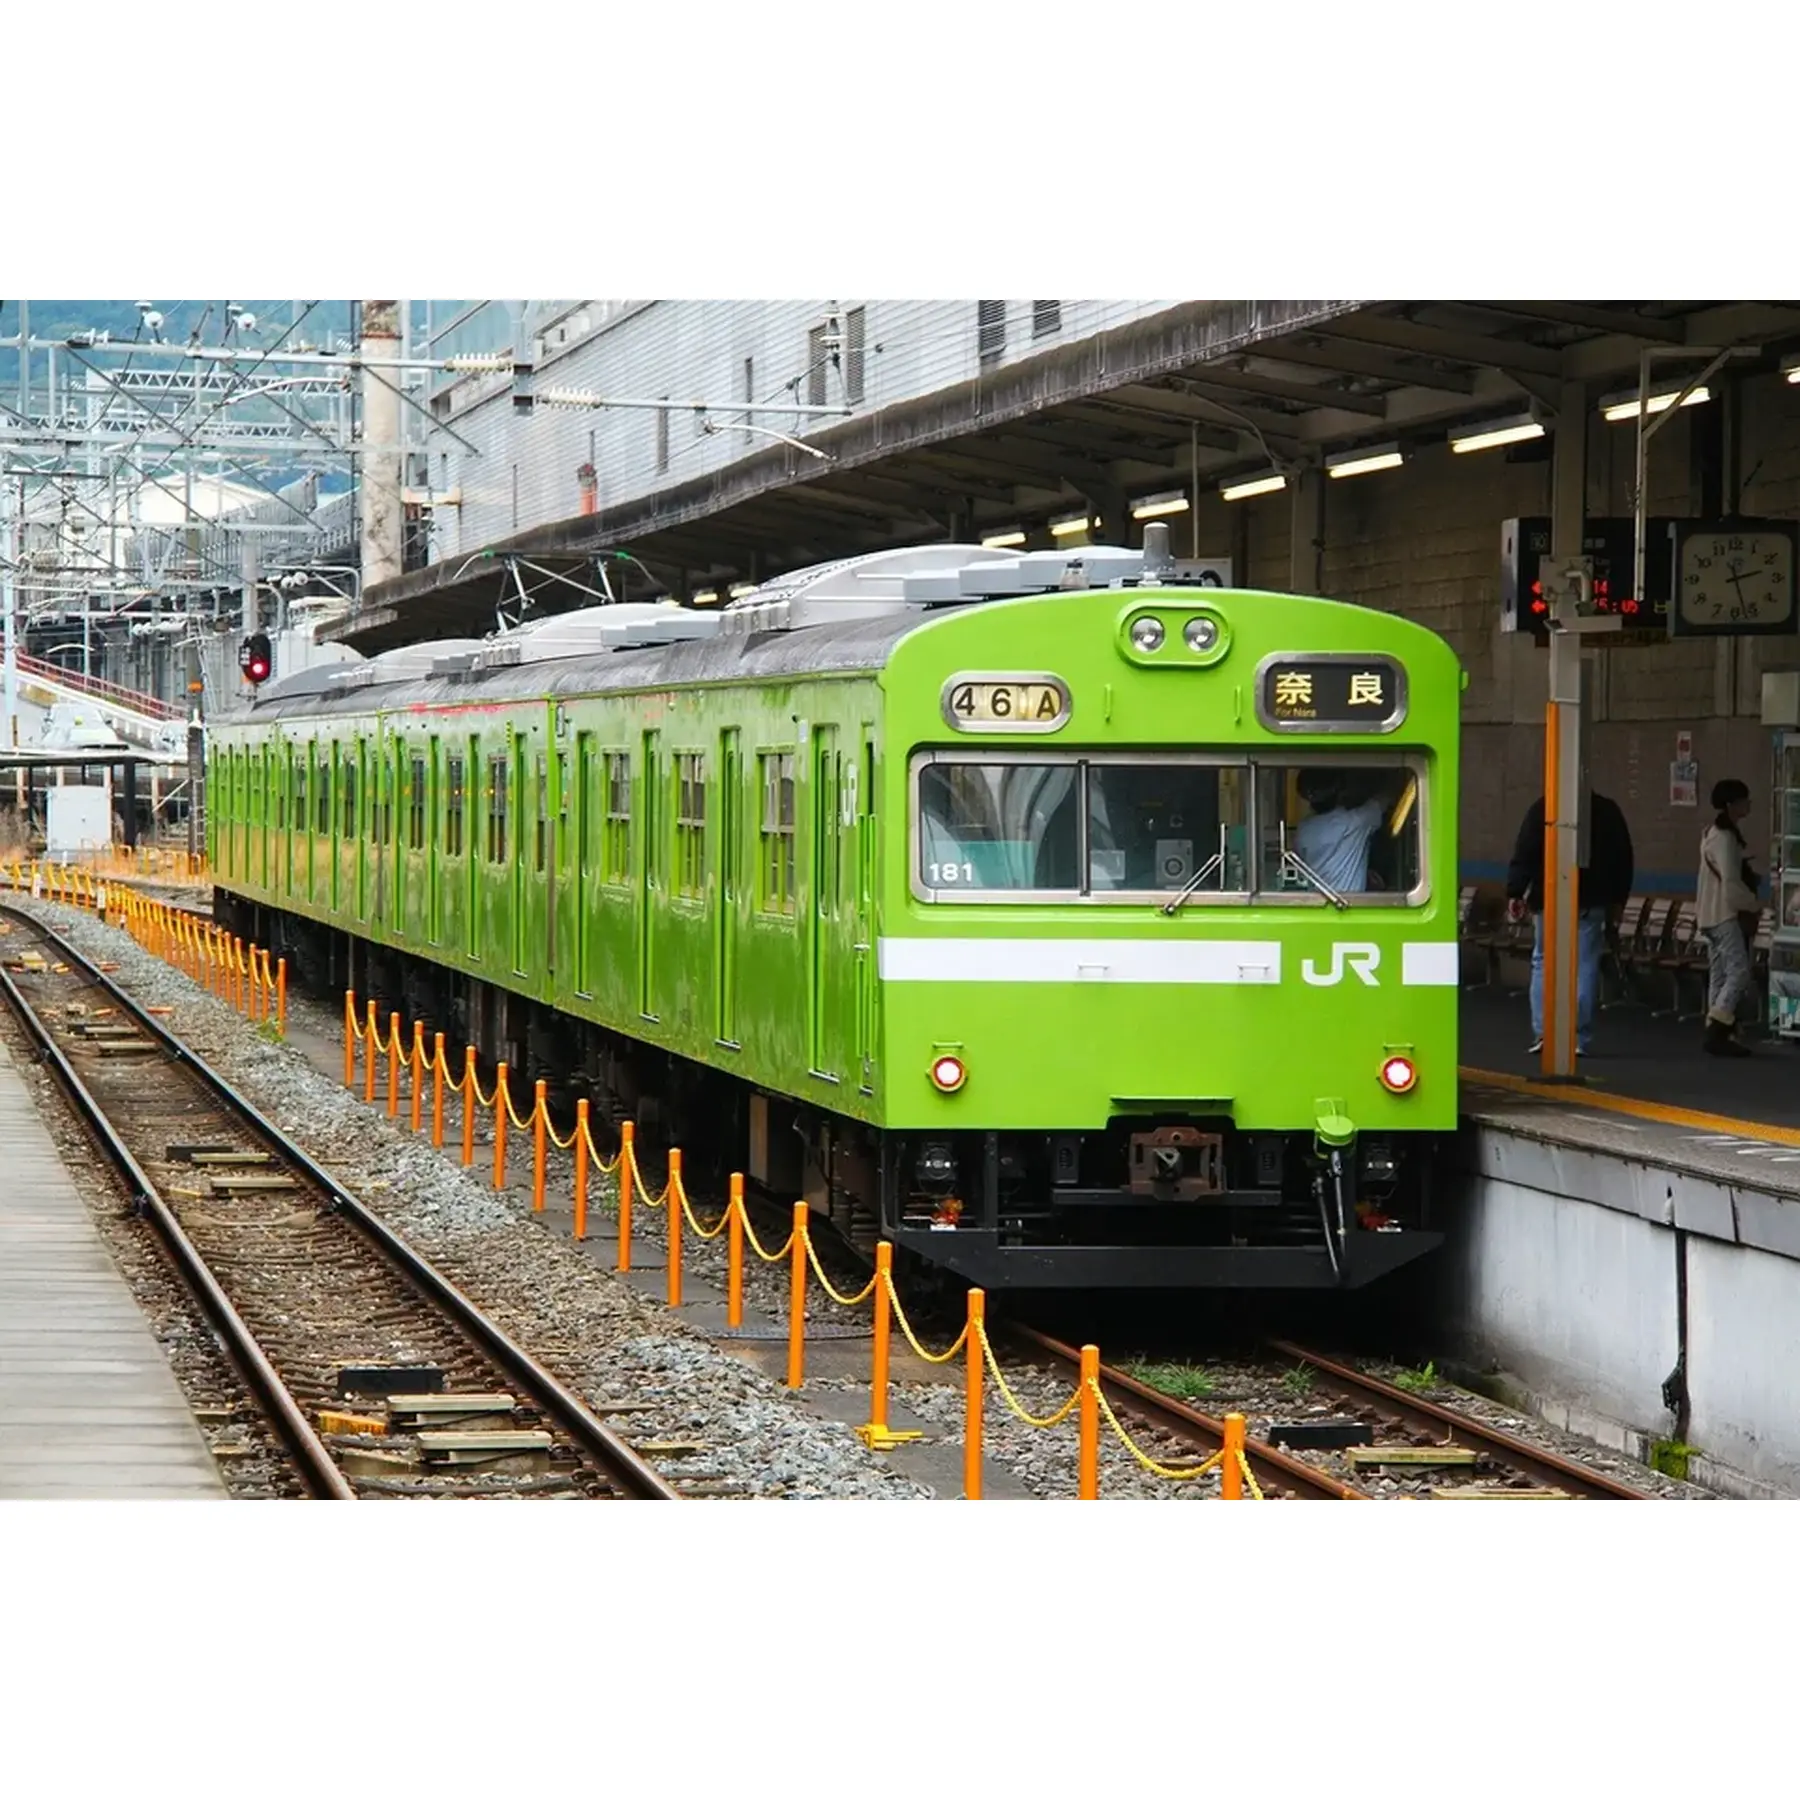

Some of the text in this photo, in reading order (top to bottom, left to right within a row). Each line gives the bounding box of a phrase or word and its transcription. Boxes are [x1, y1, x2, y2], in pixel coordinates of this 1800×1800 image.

[1276, 672, 1384, 705] 奈良
[929, 863, 973, 882] 181
[1302, 942, 1380, 986] JR
